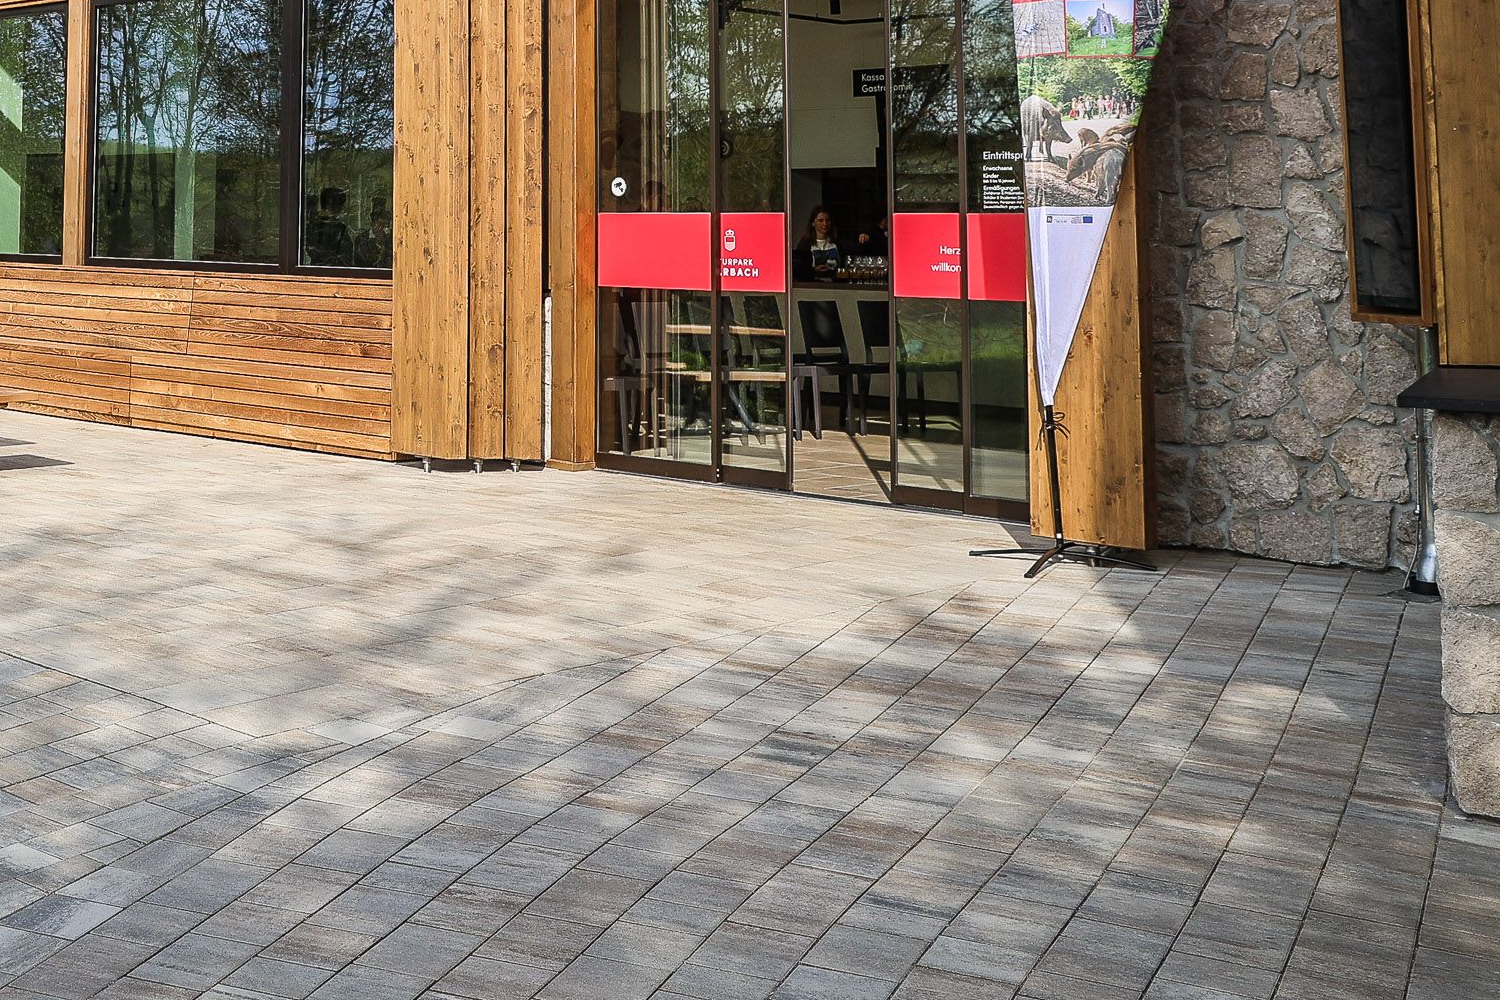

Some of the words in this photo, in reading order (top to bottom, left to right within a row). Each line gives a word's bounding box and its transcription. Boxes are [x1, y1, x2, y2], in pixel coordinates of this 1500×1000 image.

[861, 73, 885, 82] Kassa
[861, 84, 913, 93] Gastroomie
[720, 267, 759, 277] RBACH
